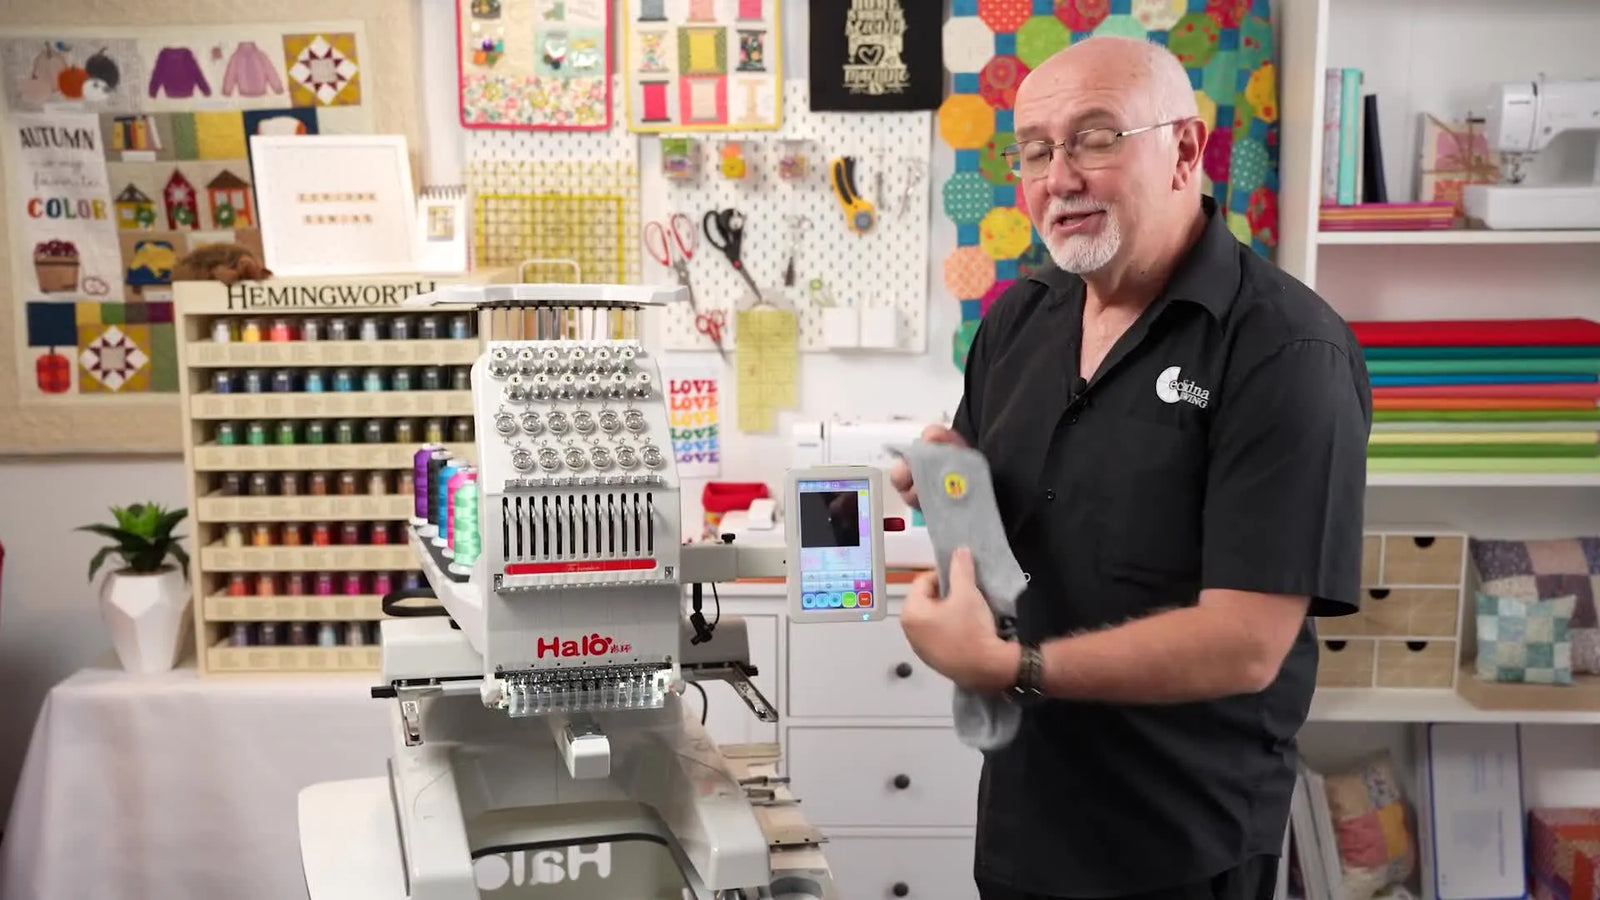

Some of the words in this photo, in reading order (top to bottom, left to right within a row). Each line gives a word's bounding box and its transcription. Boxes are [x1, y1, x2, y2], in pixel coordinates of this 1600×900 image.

[19, 125, 95, 151] AUTUMN
[27, 197, 108, 220] COLOR
[670, 379, 718, 394] LOVE
[670, 396, 718, 411] LOVE
[671, 409, 718, 427] LOVE
[670, 425, 718, 440] LOVE
[537, 633, 613, 658] Halo
